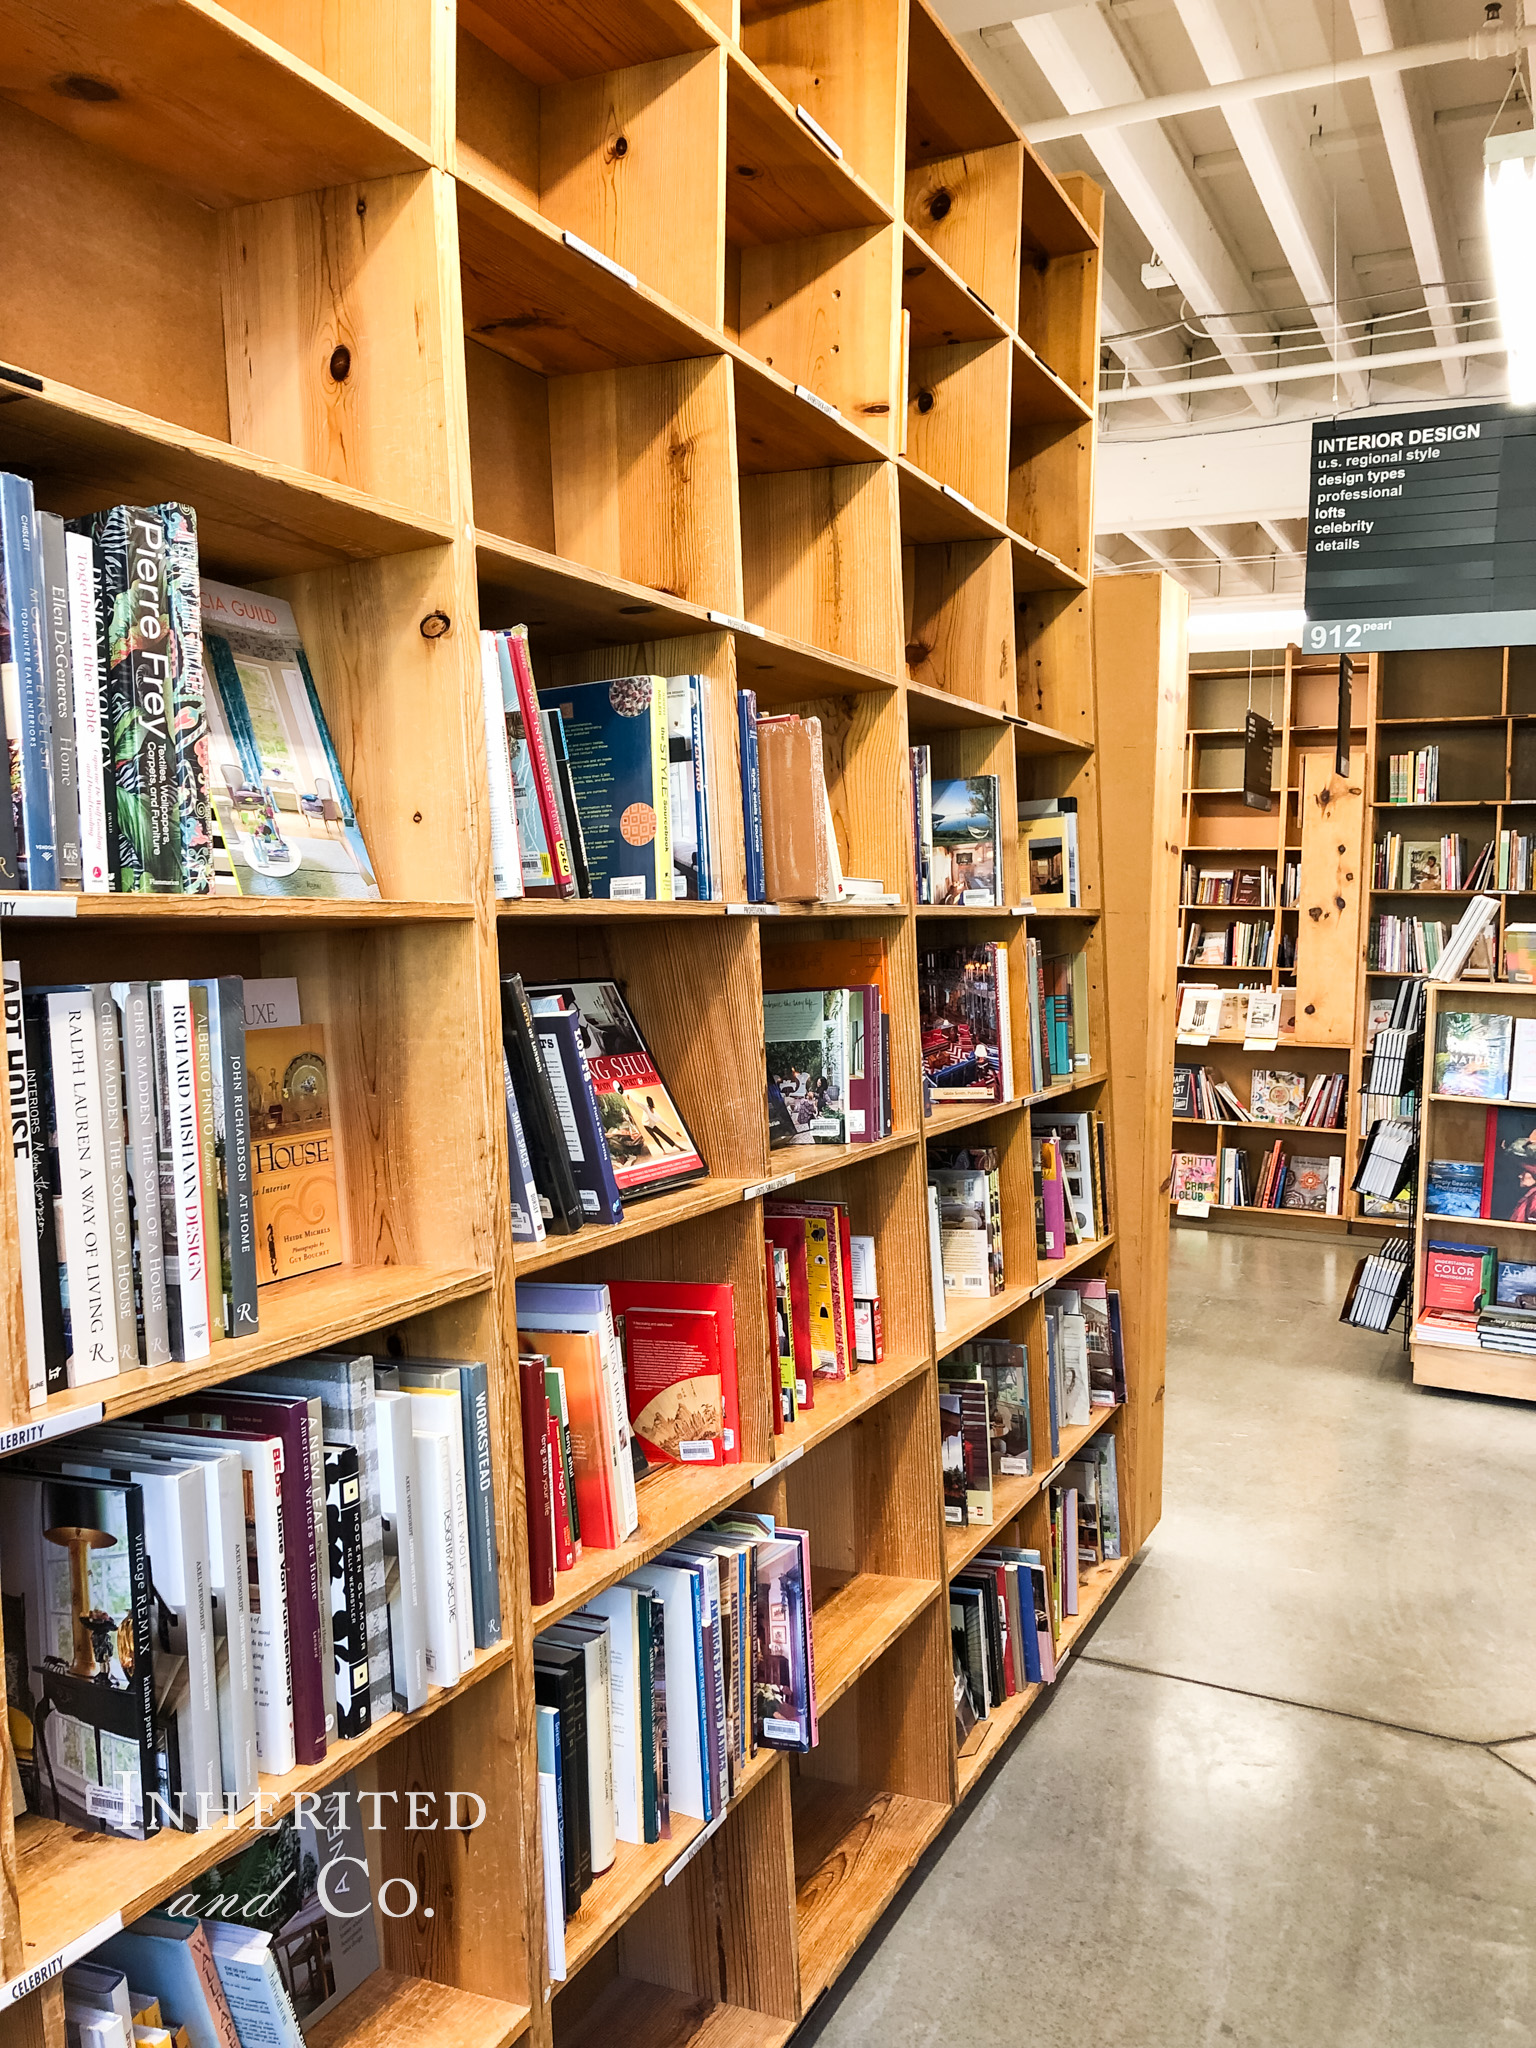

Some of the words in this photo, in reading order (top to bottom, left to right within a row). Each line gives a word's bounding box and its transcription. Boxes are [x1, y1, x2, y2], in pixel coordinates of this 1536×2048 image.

[1318, 432, 1403, 453] INTERIOR
[1408, 423, 1481, 445] DESIGN
[1318, 458, 1341, 469] u.s.
[1346, 451, 1402, 468] regional
[1406, 447, 1440, 464] style
[1317, 485, 1403, 505] professional
[1318, 473, 1363, 487] design
[1367, 468, 1405, 484] types
[20, 514, 30, 551] CHISLETT
[1314, 520, 1374, 534] celebrity
[1315, 507, 1346, 520] lofts
[1315, 538, 1360, 552] details
[77, 553, 90, 624] Together
[135, 519, 163, 640] Pierre
[52, 586, 66, 626] Ellen
[200, 592, 228, 613] CIA
[231, 600, 277, 625] GUILD
[20, 608, 31, 663] TODHUNTER
[82, 633, 92, 648] at
[1310, 624, 1362, 649] 912
[1362, 621, 1392, 633] pearl
[25, 666, 33, 693] EARLE
[55, 629, 69, 718] DeGeneres
[83, 656, 94, 681] the
[84, 686, 97, 733] Table
[139, 652, 170, 740] Frey
[28, 694, 36, 747] INTERIORS
[35, 685, 49, 771] ENGLISH
[60, 737, 72, 786] Home
[146, 741, 156, 787] Carpets,
[158, 743, 167, 784] Textiles,
[659, 744, 669, 797] STYLE
[150, 787, 159, 807] and
[160, 784, 170, 846] Wallpapers,
[151, 808, 161, 856] Furniture
[100, 1002, 114, 1052] CHRIS
[133, 999, 146, 1049] CHRIS
[243, 1003, 278, 1026] UXE
[68, 1010, 85, 1076] RALPH
[173, 1004, 191, 1098] RICHARD
[197, 1013, 210, 1083] ALBERTO
[521, 1001, 530, 1023] LOFTS
[528, 1027, 534, 1038] OF
[531, 1040, 542, 1073] LONDON
[573, 1028, 591, 1082] LOFTS
[231, 1055, 242, 1090] JOHN
[589, 1060, 611, 1080] NG
[611, 1054, 654, 1077] SHUI
[1450, 1054, 1498, 1066] NATURE
[105, 1059, 119, 1130] MADDEN
[137, 1056, 151, 1126] MADDEN
[202, 1088, 214, 1136] PINTO
[1173, 1085, 1185, 1095] AST
[73, 1082, 91, 1160] LAUREN
[234, 1095, 246, 1182] RICHARDSON
[505, 1077, 514, 1099] STYLE
[512, 1111, 522, 1137] SMALL
[518, 1139, 529, 1168] SPACES
[110, 1136, 121, 1170] THE
[142, 1133, 154, 1166] THE
[179, 1103, 197, 1199] MISHAAN
[203, 1141, 215, 1187] Classics
[256, 1140, 329, 1174] HOUSE
[1181, 1155, 1216, 1167] SHITTY
[80, 1168, 92, 1180] A
[143, 1170, 156, 1213] SOUL
[1185, 1181, 1215, 1191] CRAFT
[1435, 1184, 1473, 1194] Photographs
[81, 1185, 96, 1225] WAY
[112, 1175, 124, 1219] SOUL
[239, 1193, 249, 1210] AT
[84, 1232, 98, 1258] OF
[115, 1223, 126, 1243] OF
[146, 1217, 157, 1237] OF
[149, 1243, 158, 1254] A
[185, 1205, 202, 1281] DESIGN
[240, 1213, 250, 1253] HOME
[117, 1249, 126, 1259] A
[1434, 1264, 1474, 1276] COLOR
[87, 1265, 104, 1333] LIVING
[117, 1264, 131, 1320] HOUSE
[151, 1259, 162, 1312] HOUSE
[0, 1424, 45, 1450] LEBRITY
[308, 1418, 318, 1430] A
[475, 1390, 491, 1492] WORKSTEAD
[539, 1433, 547, 1455] feng
[300, 1417, 310, 1481] American
[309, 1436, 321, 1479] NEW
[541, 1457, 549, 1476] shui
[272, 1447, 282, 1498] BEDS
[305, 1486, 314, 1539] Writers
[313, 1488, 324, 1534] LEAF
[454, 1469, 465, 1527] VICENTE
[276, 1505, 285, 1554] Diane
[308, 1544, 315, 1557] at
[353, 1512, 362, 1573] MODERN
[458, 1530, 467, 1569] WOLF
[134, 1533, 146, 1590] vintage
[309, 1562, 317, 1600] Home
[137, 1594, 150, 1655] REMIX
[357, 1582, 367, 1651] GLAMOUR
[710, 1599, 721, 1668] AMERICA'S
[730, 1592, 739, 1657] AMERICA'S
[142, 1675, 152, 1715] kishani
[712, 1668, 723, 1722] PAINTED
[732, 1661, 740, 1713] PAINTED
[145, 1718, 154, 1750] perera
[716, 1725, 725, 1771] LADIES
[733, 1716, 741, 1762] LADIES
[334, 1871, 350, 1894] A
[12, 1955, 63, 2000] CELEBRITY
